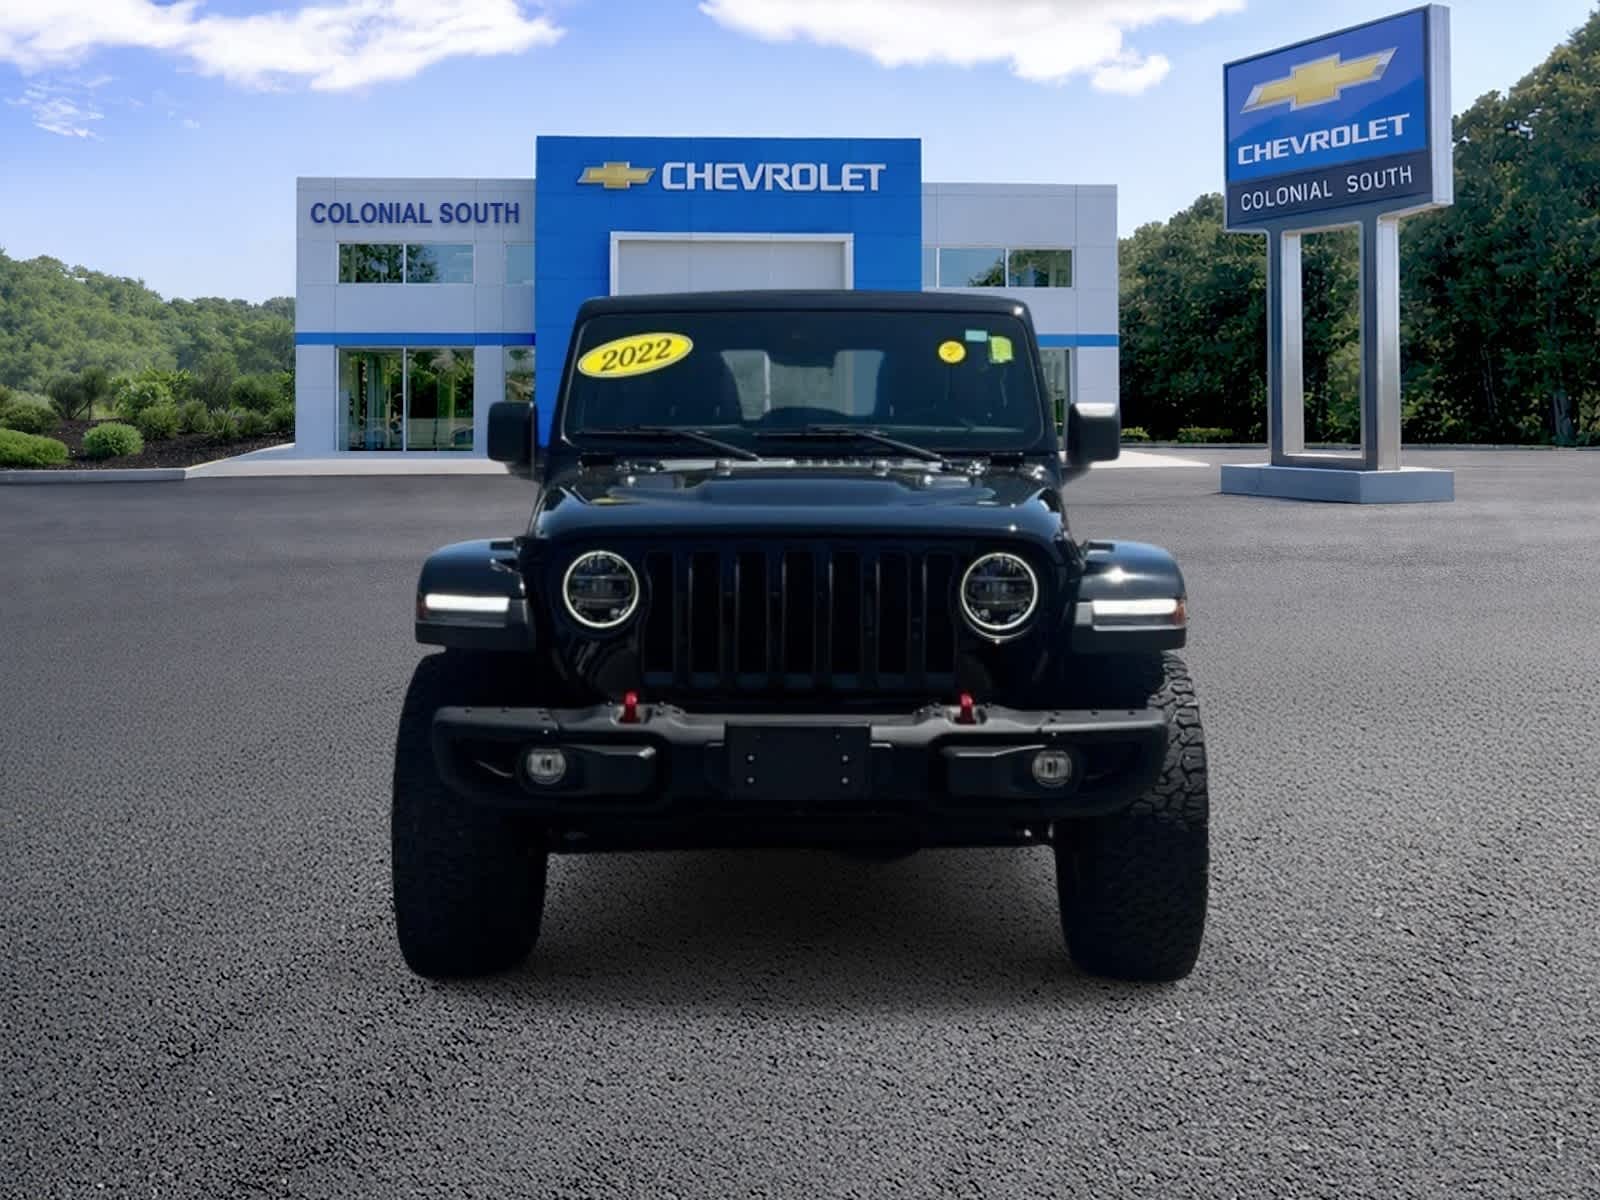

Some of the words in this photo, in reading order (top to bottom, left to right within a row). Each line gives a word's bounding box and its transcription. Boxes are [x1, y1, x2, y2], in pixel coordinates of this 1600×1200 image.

[1238, 113, 1410, 165] CHEVROLET
[662, 162, 886, 191] CHEVROLET
[1240, 180, 1333, 211] COLONIAL
[1346, 165, 1412, 193] SOUTH
[311, 202, 433, 224] COLONIAL
[439, 202, 519, 224] SOUTH
[601, 339, 672, 372] 2022
